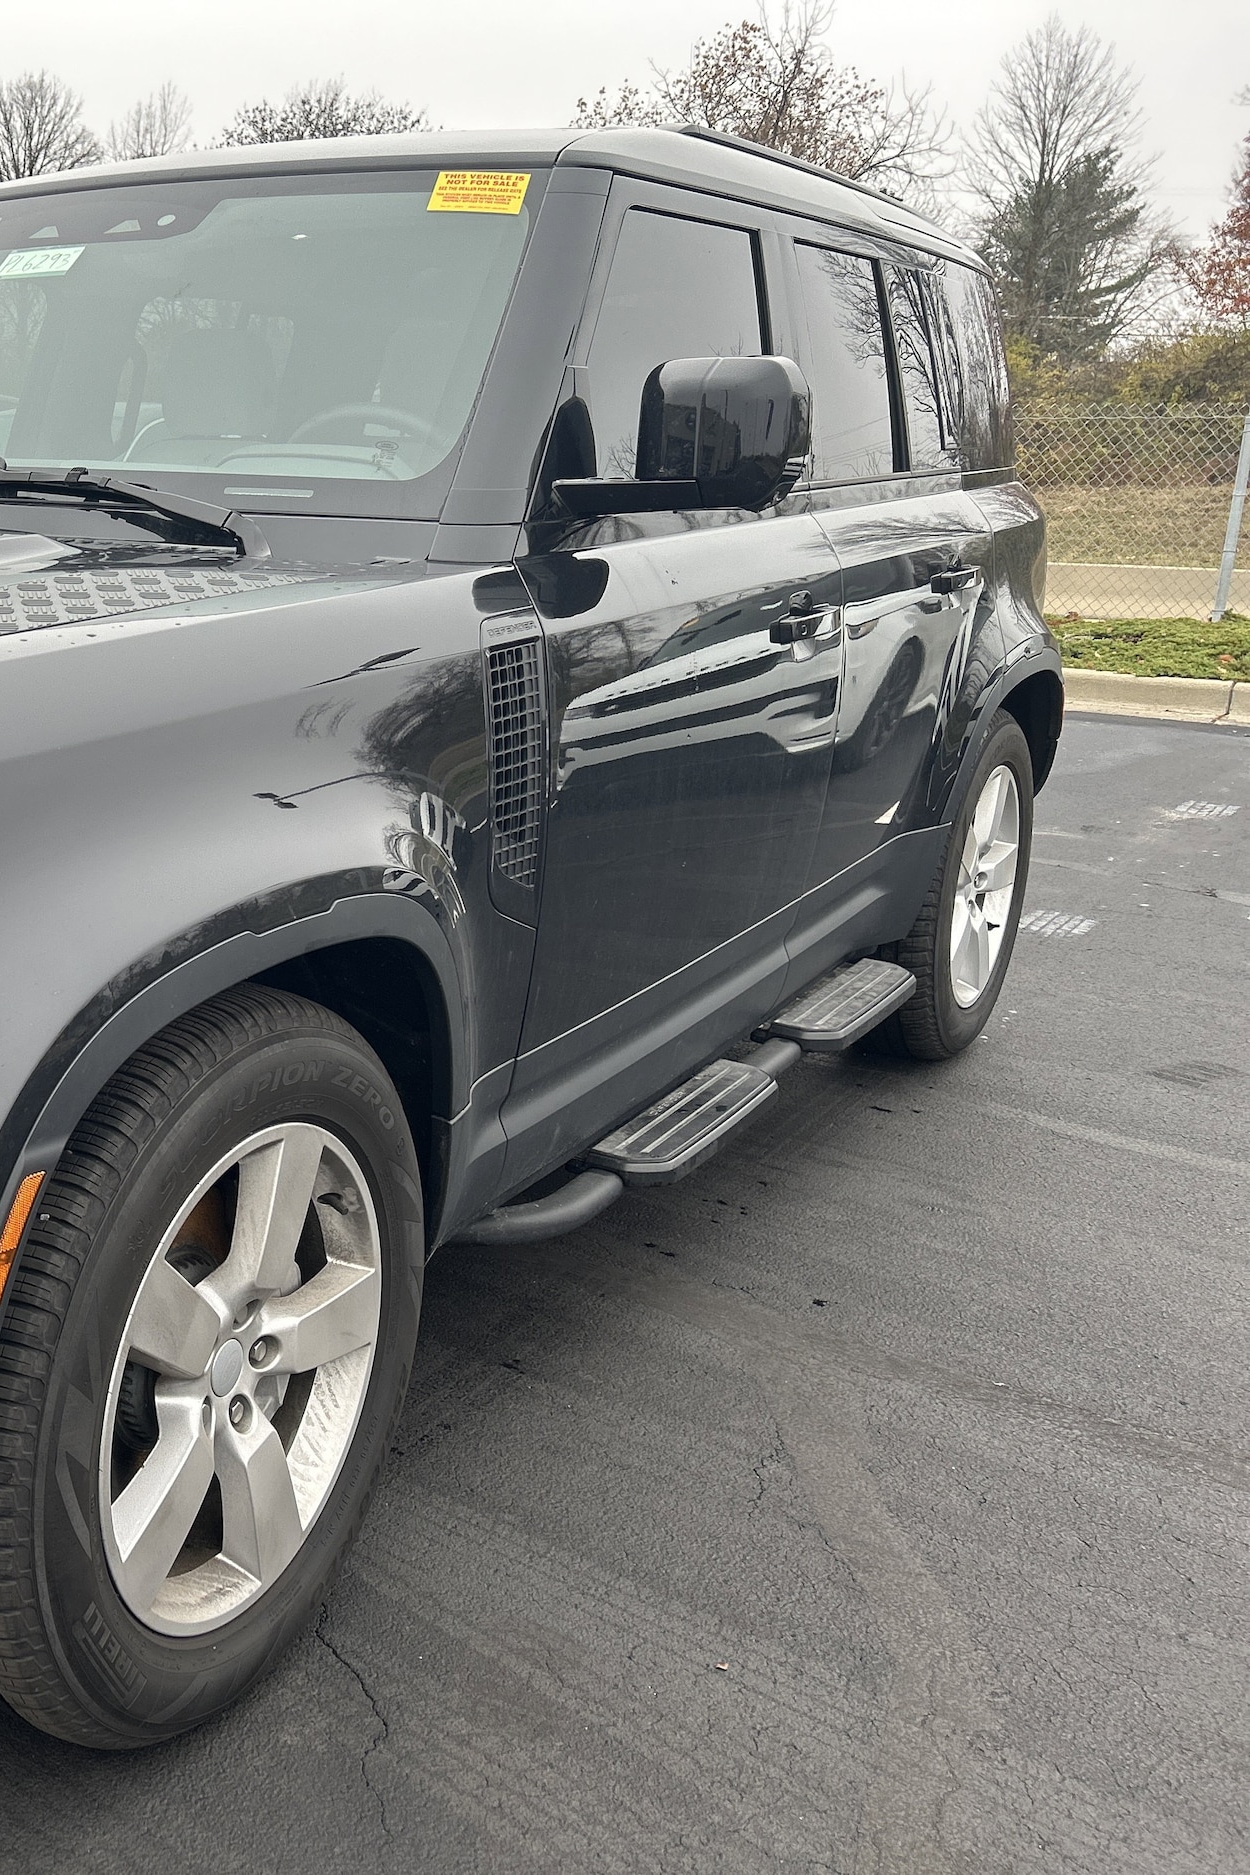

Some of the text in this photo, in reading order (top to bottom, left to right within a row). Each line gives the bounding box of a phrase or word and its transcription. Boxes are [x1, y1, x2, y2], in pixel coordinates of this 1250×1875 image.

[486, 620, 537, 638] DEFENDER
[160, 1059, 395, 1208] SCORPION ZERO
